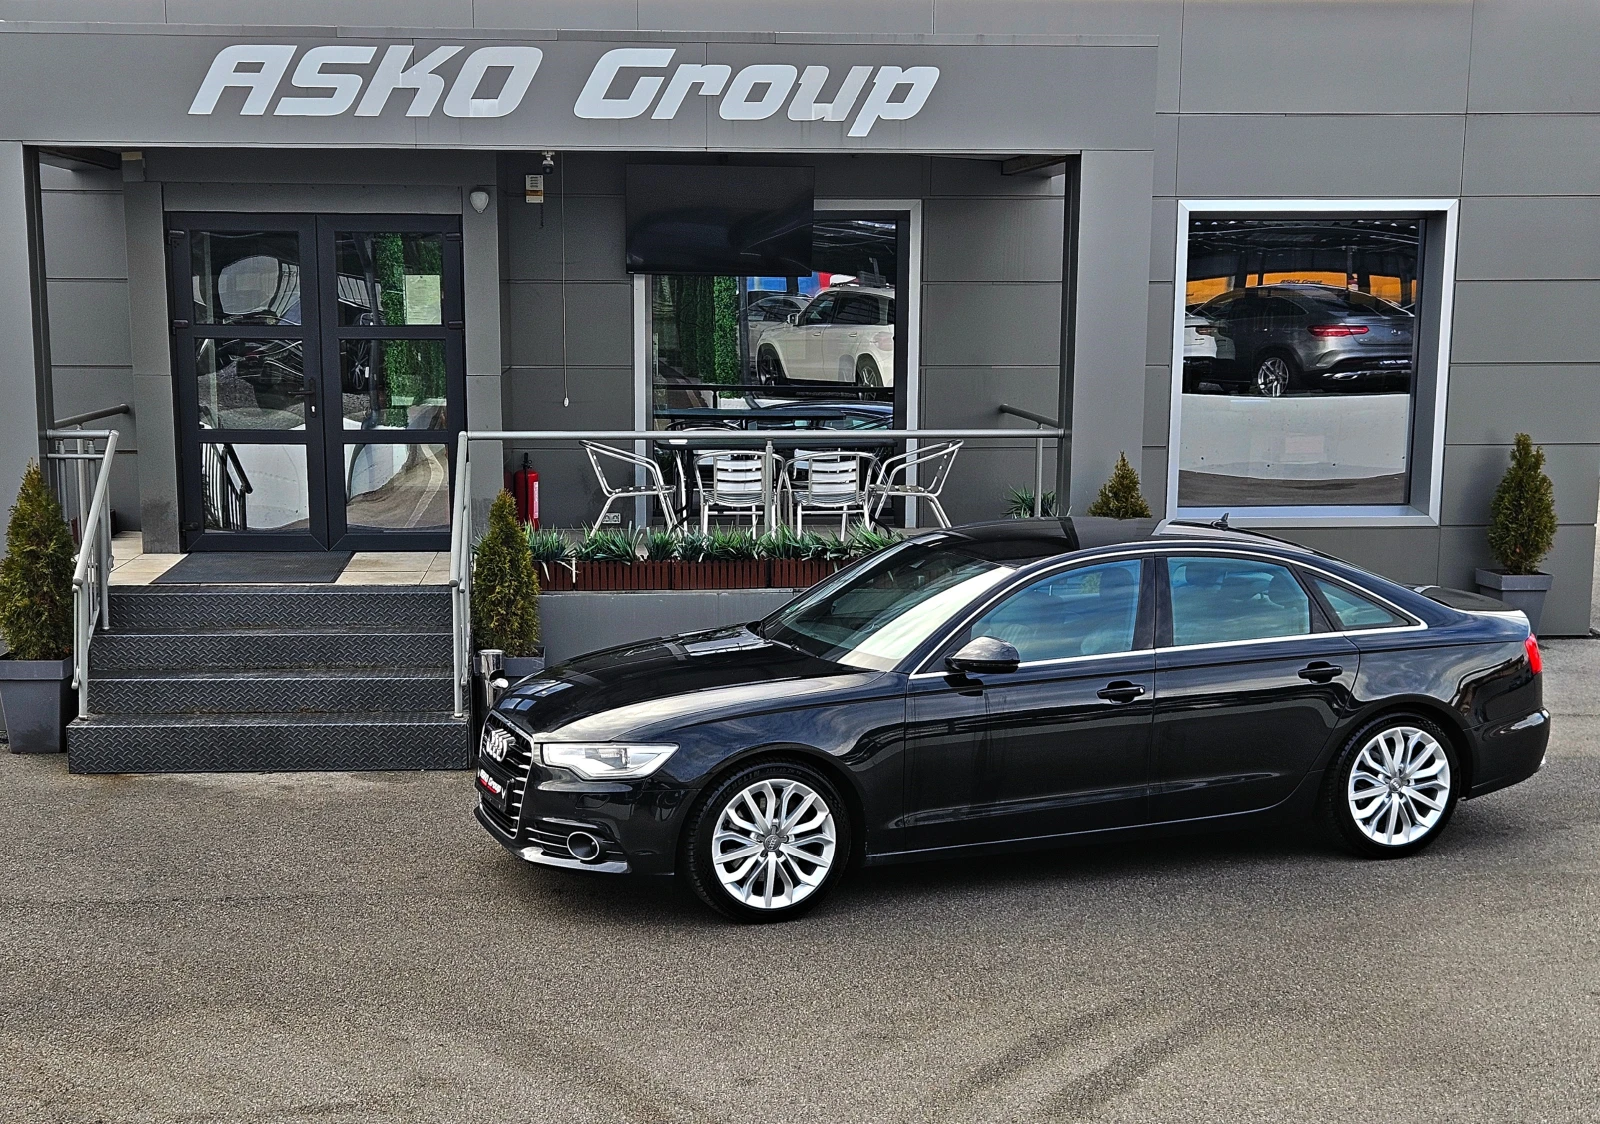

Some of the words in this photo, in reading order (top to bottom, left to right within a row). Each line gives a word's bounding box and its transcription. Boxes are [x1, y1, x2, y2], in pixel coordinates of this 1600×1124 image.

[188, 44, 543, 119] ASKO
[573, 46, 940, 138] Group
[716, 769, 760, 804] MICHELIN
